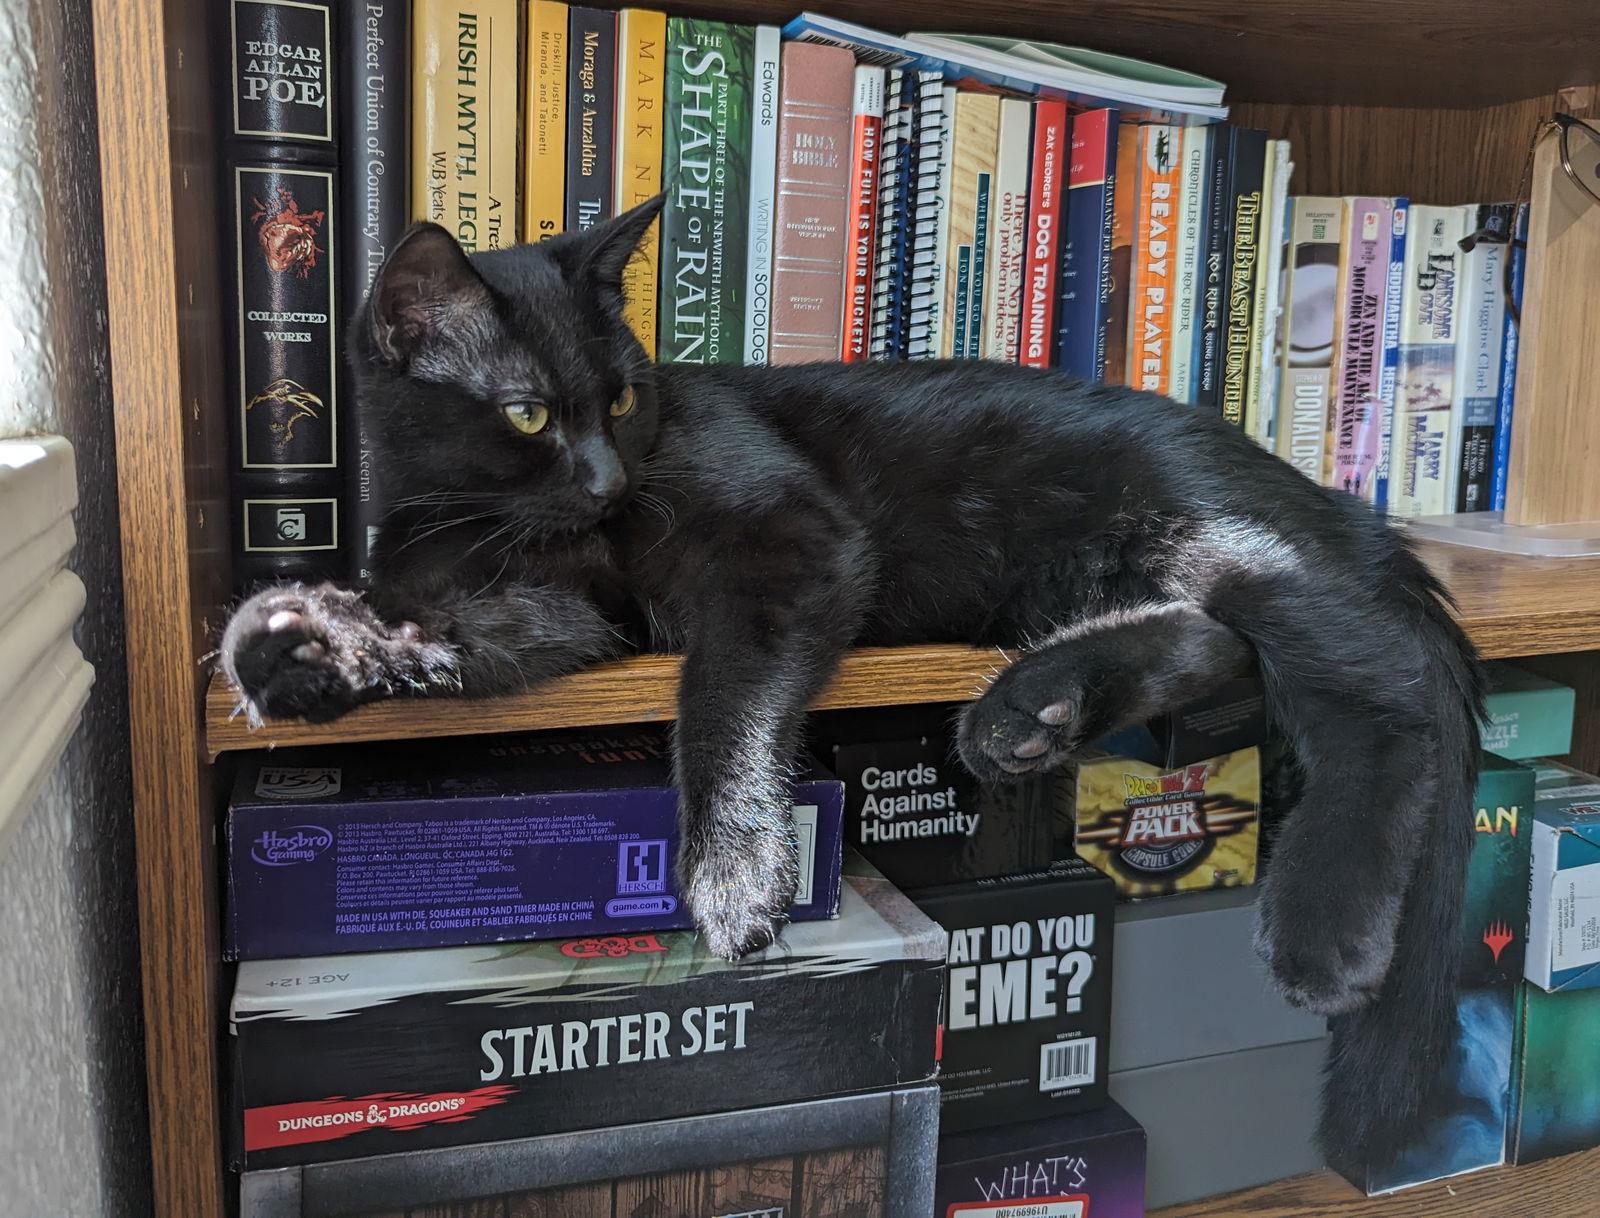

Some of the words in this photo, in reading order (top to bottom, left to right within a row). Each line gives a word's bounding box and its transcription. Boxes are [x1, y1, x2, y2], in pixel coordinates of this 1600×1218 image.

[245, 41, 321, 62] EDGAR
[366, 3, 384, 69] Perfect
[458, 11, 477, 86] IRISH
[552, 32, 562, 75] Driskill,
[694, 35, 722, 48] THE
[245, 61, 322, 80] ALLAN
[540, 31, 550, 78] Miranda,
[579, 31, 599, 89] Moraga
[243, 76, 325, 109] POE
[366, 74, 384, 131] Union
[540, 84, 548, 102] and
[552, 80, 561, 123] Justice,
[584, 94, 596, 103] &
[637, 40, 655, 139] MARK
[717, 83, 728, 118] PART
[761, 61, 775, 126] Edwards
[456, 93, 476, 181] MYTH,
[539, 109, 548, 155] Tatonetti
[581, 107, 599, 176] Anzaldúa
[676, 44, 728, 209] SHAPE
[715, 119, 726, 164] THREE
[862, 127, 874, 162] HOW
[1046, 126, 1055, 150] ZAK
[367, 137, 384, 155] of
[715, 168, 725, 187] OF
[860, 168, 872, 206] FULL
[1042, 153, 1053, 208] GEORGE'S
[1187, 149, 1201, 224] CHRONICLES
[362, 160, 385, 242] Contrary
[427, 184, 447, 220] Yeats
[489, 196, 501, 210] A
[579, 198, 601, 232] This
[714, 189, 724, 217] THE
[998, 192, 1012, 224] only
[1012, 192, 1027, 244] There
[1103, 174, 1114, 233] SHAMANIC
[1236, 192, 1260, 243] THE
[688, 216, 701, 243] OF
[756, 199, 769, 253] WRITING
[859, 215, 869, 229] IS
[975, 193, 987, 264] WHEREVER
[1035, 214, 1051, 259] DOG
[1147, 182, 1171, 277] READY
[1187, 227, 1195, 243] OF
[711, 220, 723, 284] NEWIRTH
[755, 257, 767, 269] IN
[855, 236, 868, 277] YOUR
[998, 230, 1011, 293] problem
[1011, 250, 1023, 280] Are
[1100, 233, 1112, 303] JOURNEYING
[1184, 245, 1195, 268] THE
[1206, 253, 1221, 283] ROC
[1482, 247, 1498, 285] Mary
[959, 258, 967, 283] JON
[973, 271, 983, 297] YOU
[1182, 272, 1192, 295] ROC
[1229, 242, 1254, 326] BEAST
[641, 271, 653, 342] THINGS
[673, 247, 708, 364] RAIN
[1008, 284, 1022, 309] No
[1028, 264, 1048, 358] TRAINING
[1203, 287, 1219, 330] RIDER
[1347, 266, 1366, 354] MOTORCYCLE
[1362, 294, 1378, 320] ZEN
[1385, 262, 1403, 349] SIDDHARTHA
[1417, 264, 1437, 325] DOVE
[1428, 250, 1455, 339] LONESOME
[248, 311, 327, 323] COLLECTED
[851, 285, 866, 354] BUCKET?
[995, 296, 1006, 339] riders
[1178, 297, 1191, 333] RIDER
[1479, 290, 1495, 349] Higgins
[263, 331, 311, 342] WORKS
[1098, 326, 1106, 362] SANDRA
[1142, 287, 1165, 392] PLAYER
[1204, 333, 1214, 359] RISING
[1361, 322, 1376, 348] AND
[1202, 361, 1212, 390] STORM
[1358, 350, 1374, 380] THE
[1476, 352, 1489, 391] Clark
[1340, 358, 1359, 449] MAINTENANCE
[1356, 382, 1372, 404] ART
[1381, 366, 1396, 434] HERMANN
[1355, 407, 1371, 424] OF
[1377, 437, 1390, 480] HESSE
[1423, 431, 1444, 480] LARRY
[360, 449, 375, 502] Keenan
[262, 774, 337, 787] USA
[861, 762, 937, 790] Cards
[861, 787, 957, 819] Against
[1125, 795, 1163, 805] Collectible
[1132, 802, 1194, 819] POWER
[254, 831, 328, 850] Hasbro
[861, 811, 980, 843] Humanity
[1125, 813, 1201, 842] PACK
[267, 847, 314, 862] Gaming
[337, 855, 366, 863] HASBRO
[619, 882, 663, 891] HERSCH
[336, 914, 360, 923] MADE
[362, 913, 370, 921] IN
[372, 912, 388, 921] USA
[390, 911, 411, 921] WITH
[429, 907, 470, 919] SQUEAKER
[471, 907, 489, 917] AND
[490, 906, 512, 916] SAND
[514, 904, 536, 914] TIMER
[538, 903, 560, 912] MADE
[561, 902, 569, 911] IN
[571, 900, 594, 910] CHINA
[377, 922, 395, 931] AUX
[430, 917, 470, 929] COUINEUR
[472, 917, 481, 926] ET
[482, 915, 513, 926] SABLIER
[559, 913, 568, 922] EN
[570, 911, 592, 921] CHINE
[613, 902, 658, 912] game.com
[991, 922, 1031, 958] DO
[1038, 914, 1094, 952] YOU
[266, 978, 302, 987] 12+
[309, 974, 350, 984] AGE
[480, 1012, 671, 1081] STARTER
[680, 1001, 754, 1056] SET
[278, 1110, 363, 1132] DUNGEONS
[366, 1105, 387, 1124] &
[975, 1156, 1087, 1202] WHAT'S
